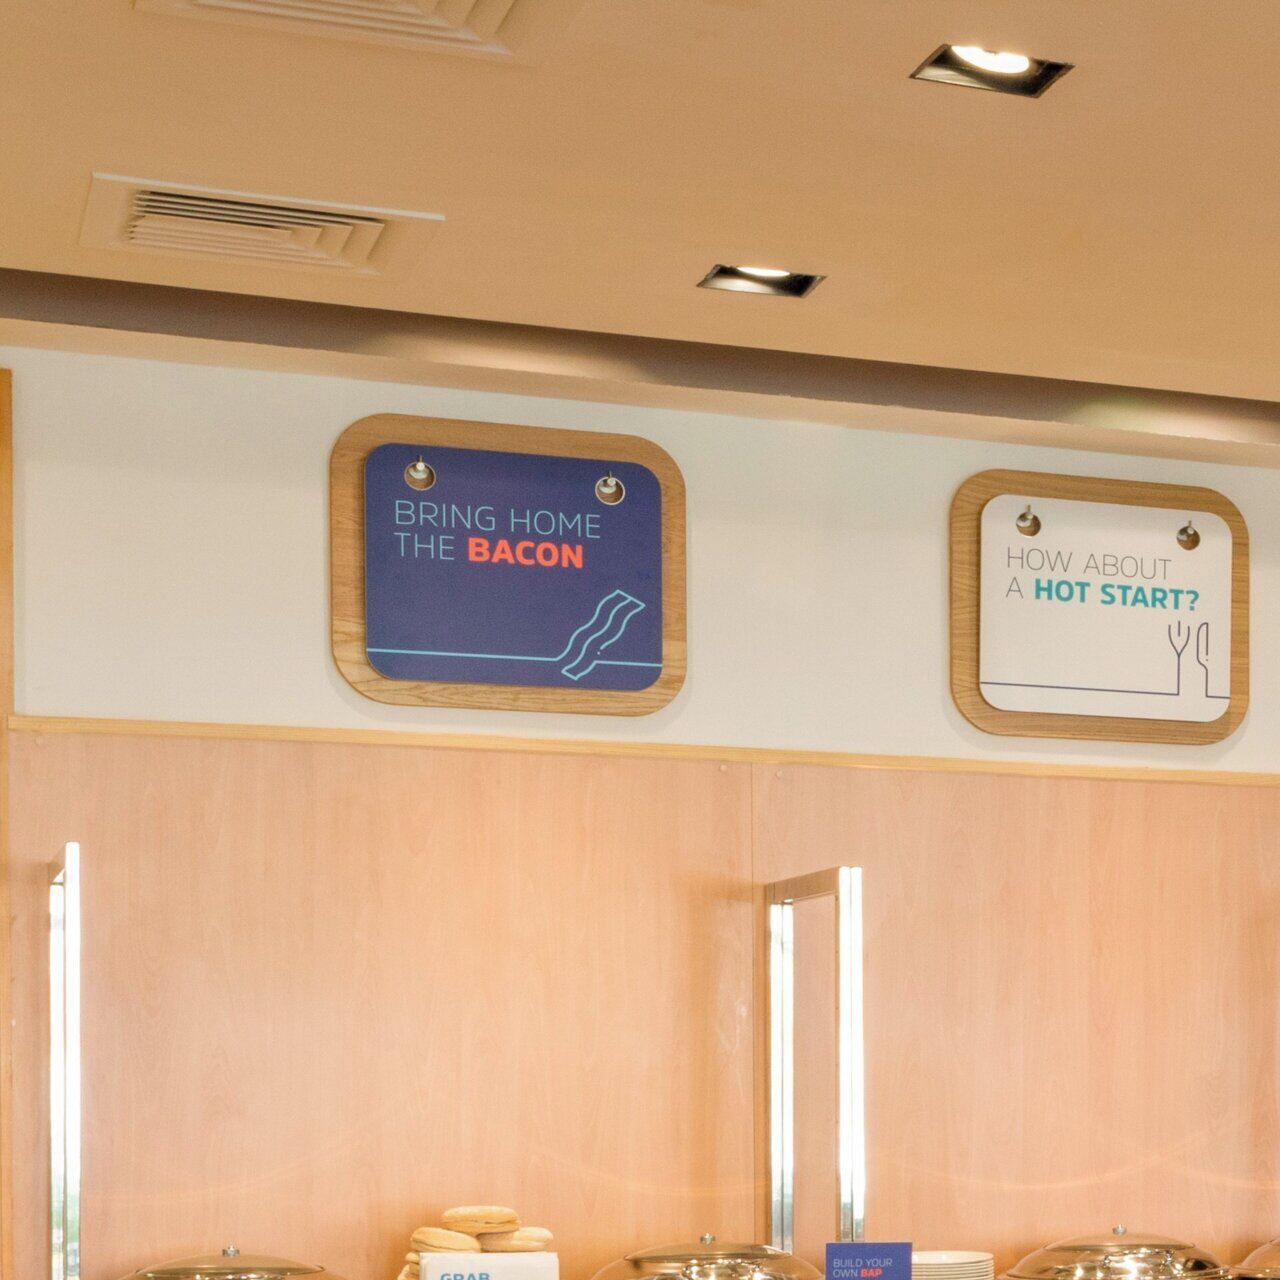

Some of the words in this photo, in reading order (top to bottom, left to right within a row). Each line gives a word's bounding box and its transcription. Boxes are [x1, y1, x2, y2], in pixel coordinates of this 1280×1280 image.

[395, 500, 496, 531] BRING
[510, 508, 600, 539] HOME
[394, 532, 454, 560] THE
[468, 537, 583, 569] BACON
[1006, 546, 1073, 573] HOW
[1083, 553, 1172, 580] ABOUT
[1005, 576, 1024, 599] A
[1035, 578, 1091, 603] HOT
[1100, 583, 1200, 611] START?
[832, 1258, 863, 1268] BUILD
[866, 1258, 893, 1267] YOUR
[832, 1268, 858, 1278] OWN
[859, 1268, 883, 1278] BAP
